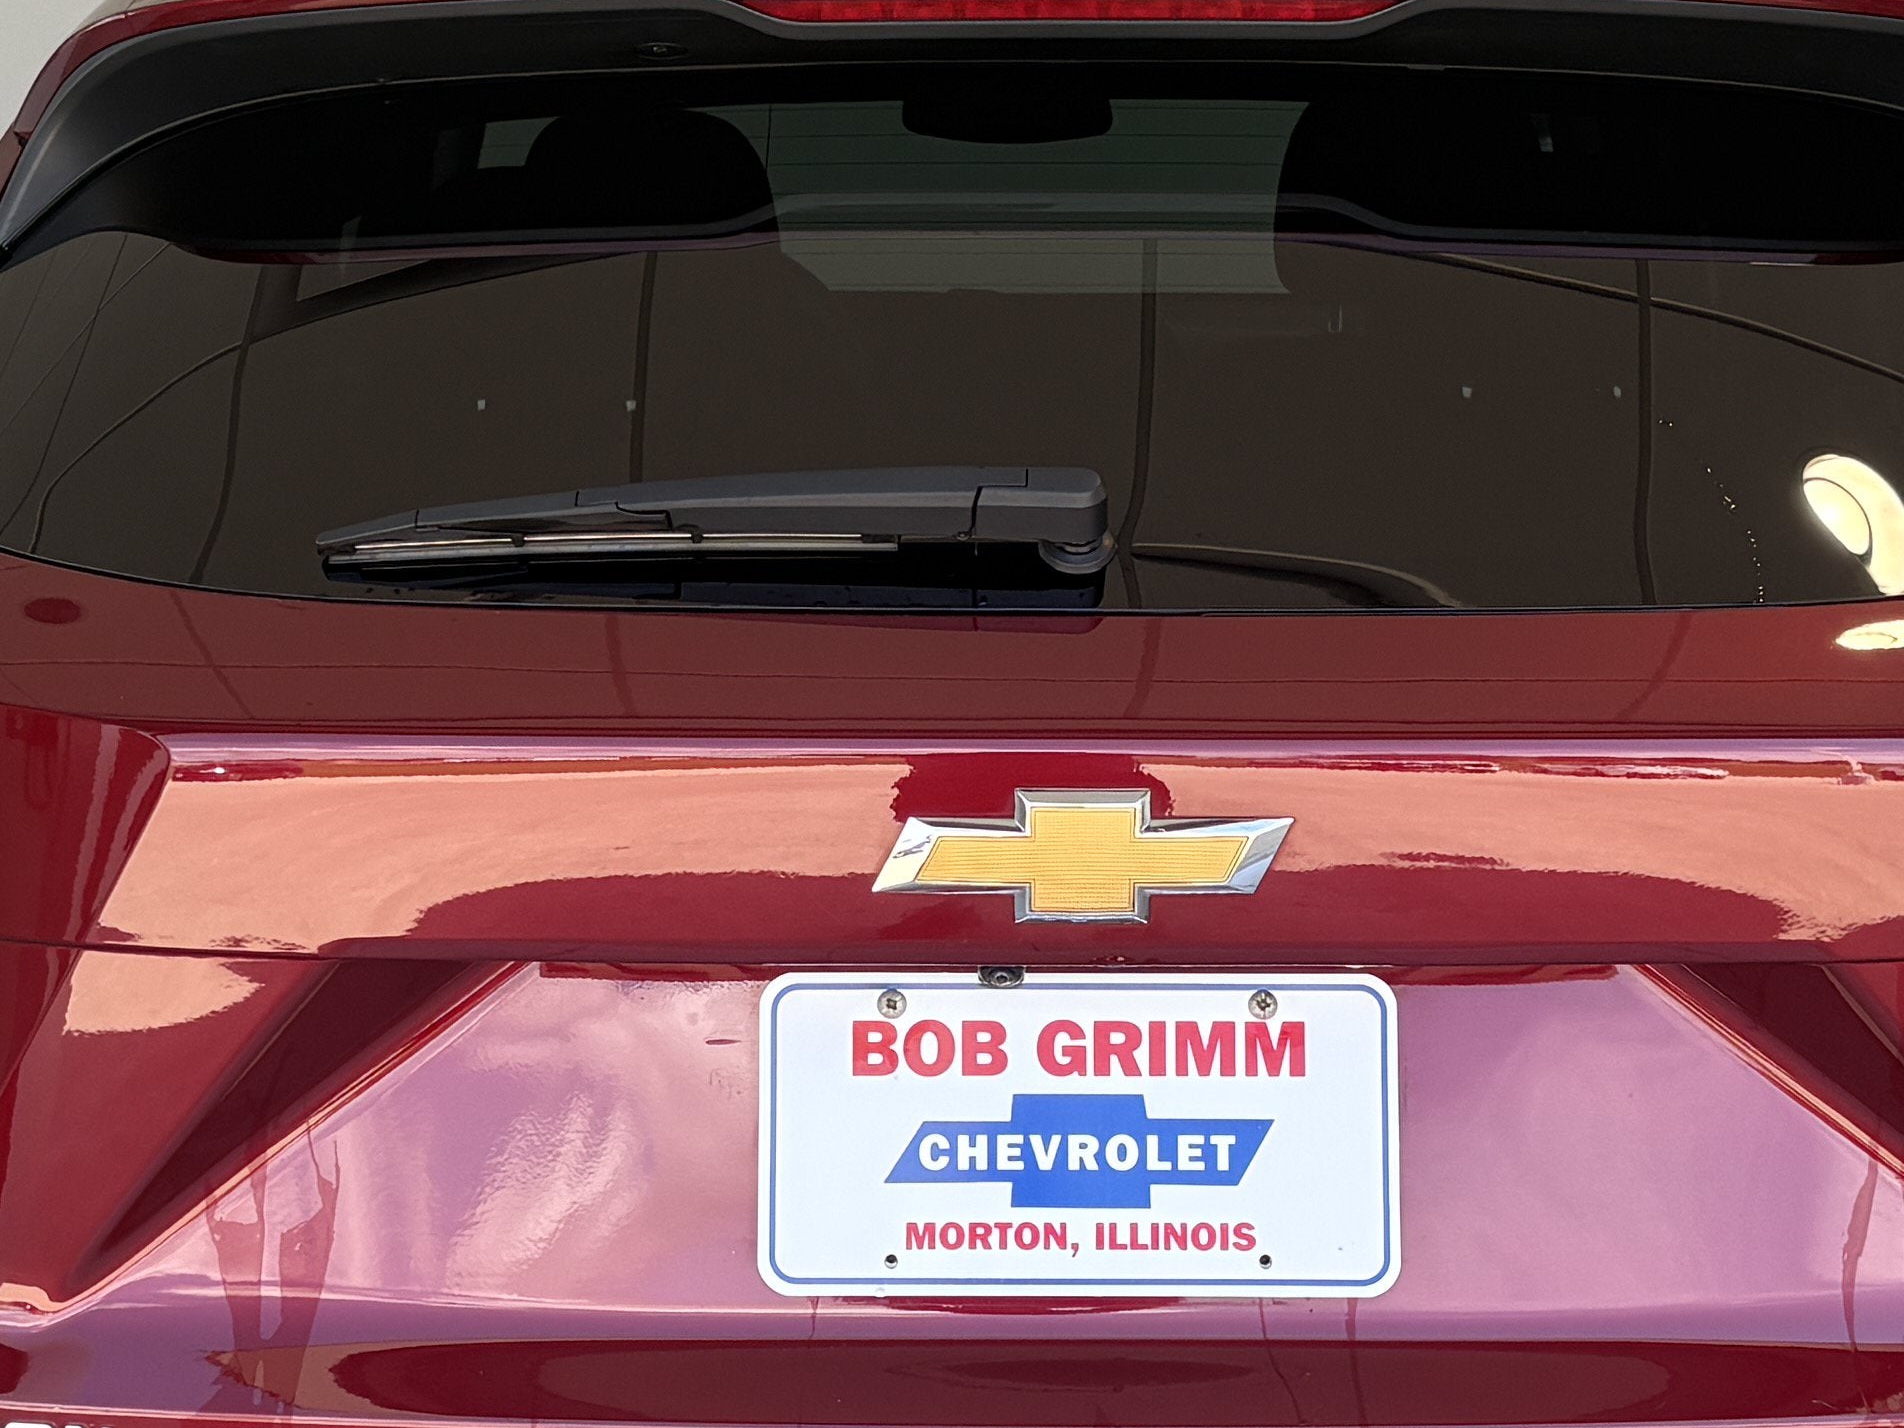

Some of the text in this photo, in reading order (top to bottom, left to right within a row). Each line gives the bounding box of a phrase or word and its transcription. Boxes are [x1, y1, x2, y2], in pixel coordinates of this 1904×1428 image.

[852, 1019, 1307, 1078] BOB GRIMM
[917, 1133, 1237, 1172] CHEVROLET
[904, 1222, 1257, 1257] MORTON, ILLINOIS
